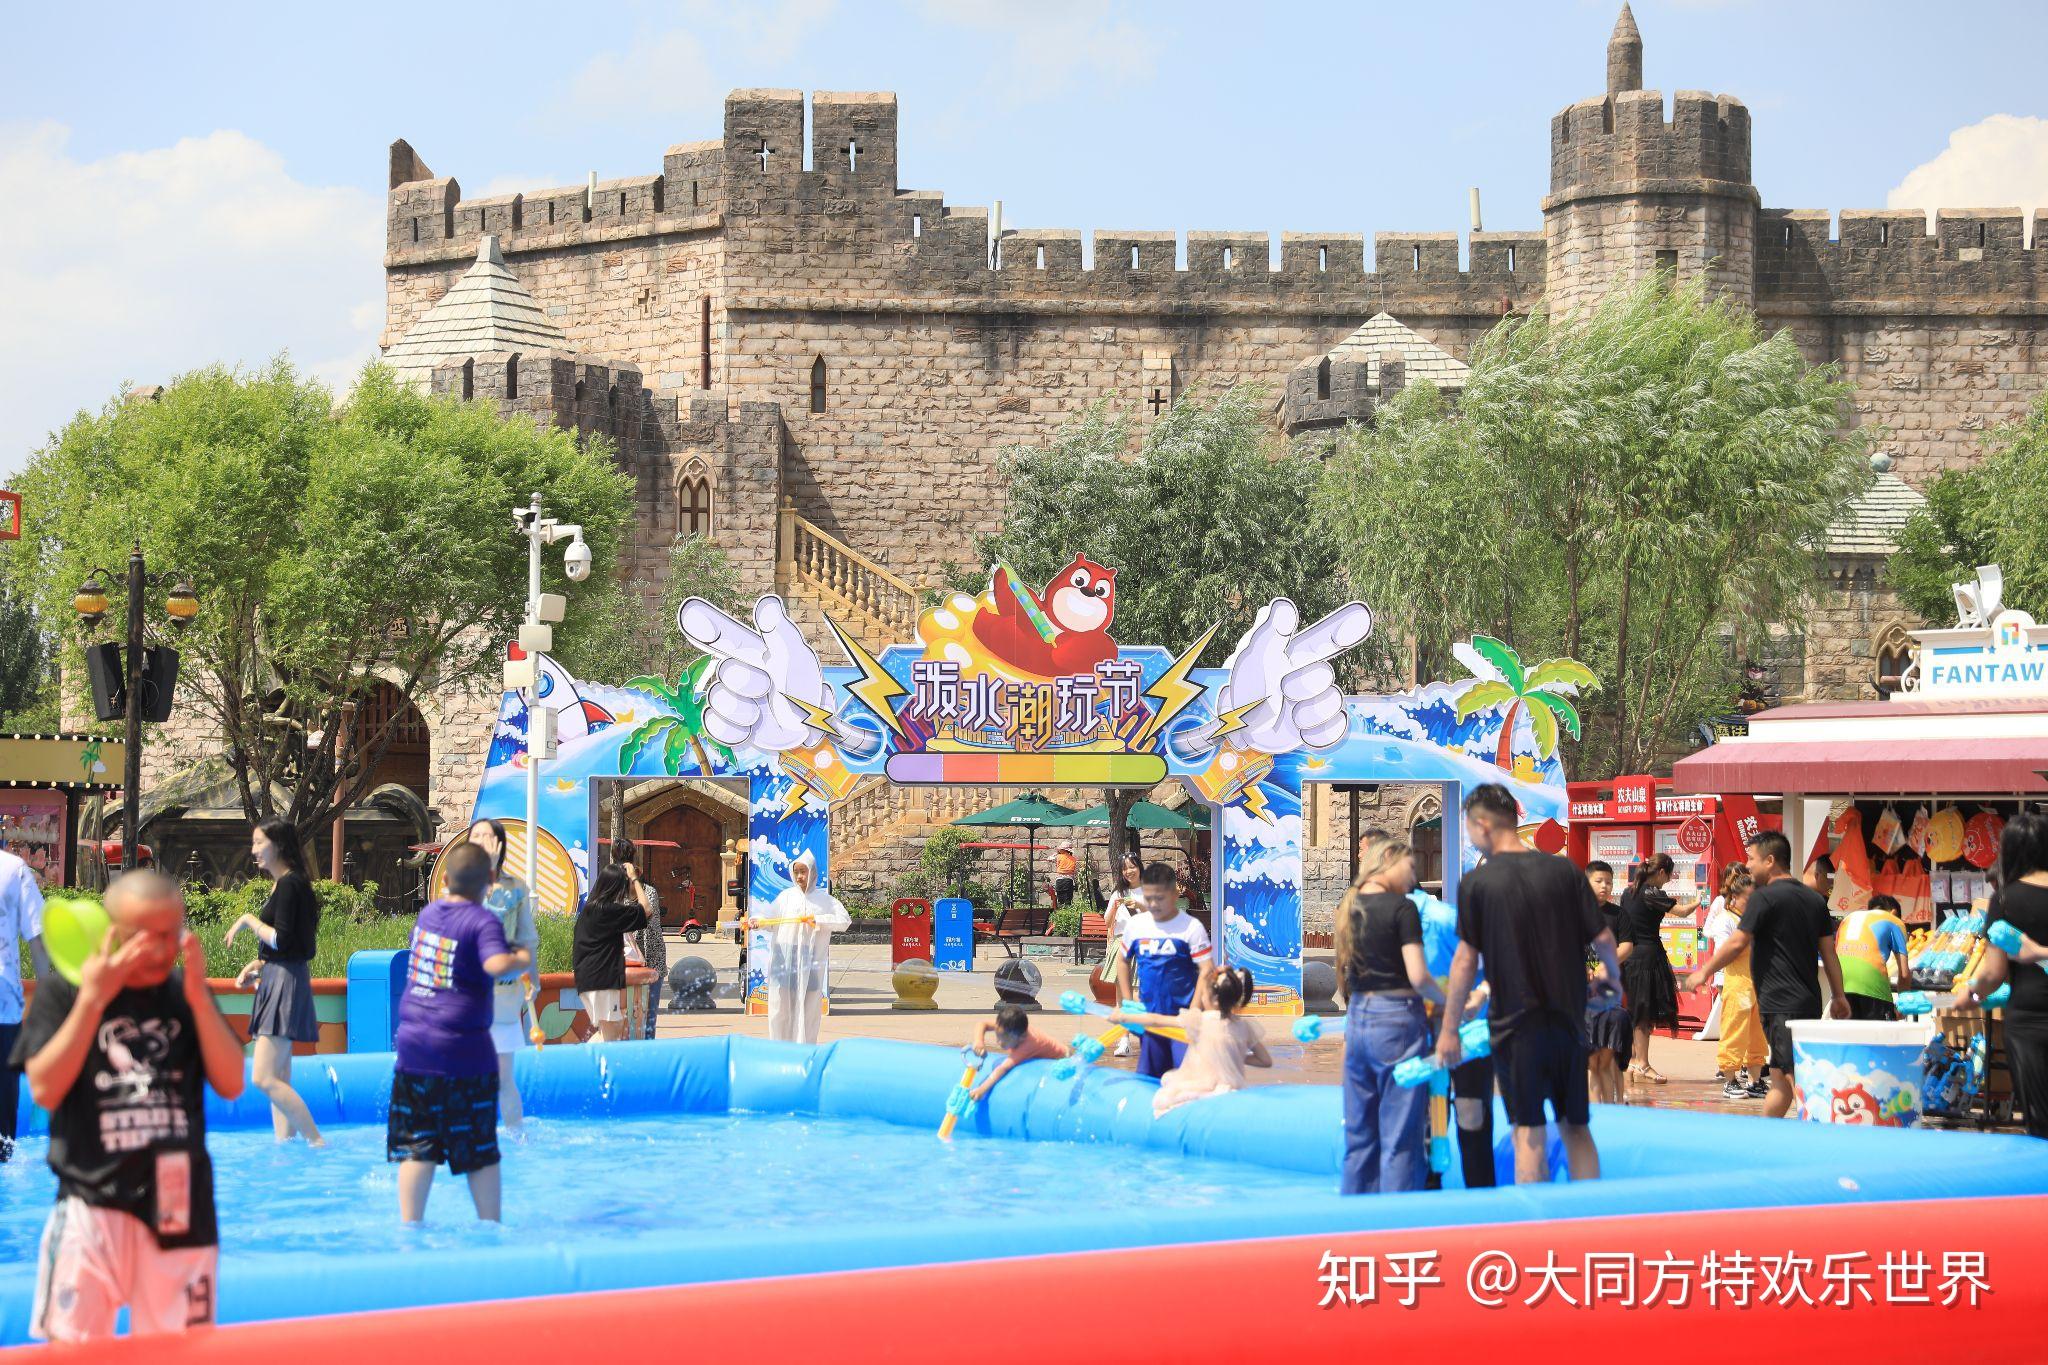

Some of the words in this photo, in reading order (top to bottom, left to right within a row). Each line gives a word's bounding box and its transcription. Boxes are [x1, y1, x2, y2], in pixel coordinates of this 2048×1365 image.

[1932, 663, 2044, 684] FANTAW
[914, 661, 1141, 750] 泼水潮玩节
[1617, 786, 1646, 803] 农夫山泉
